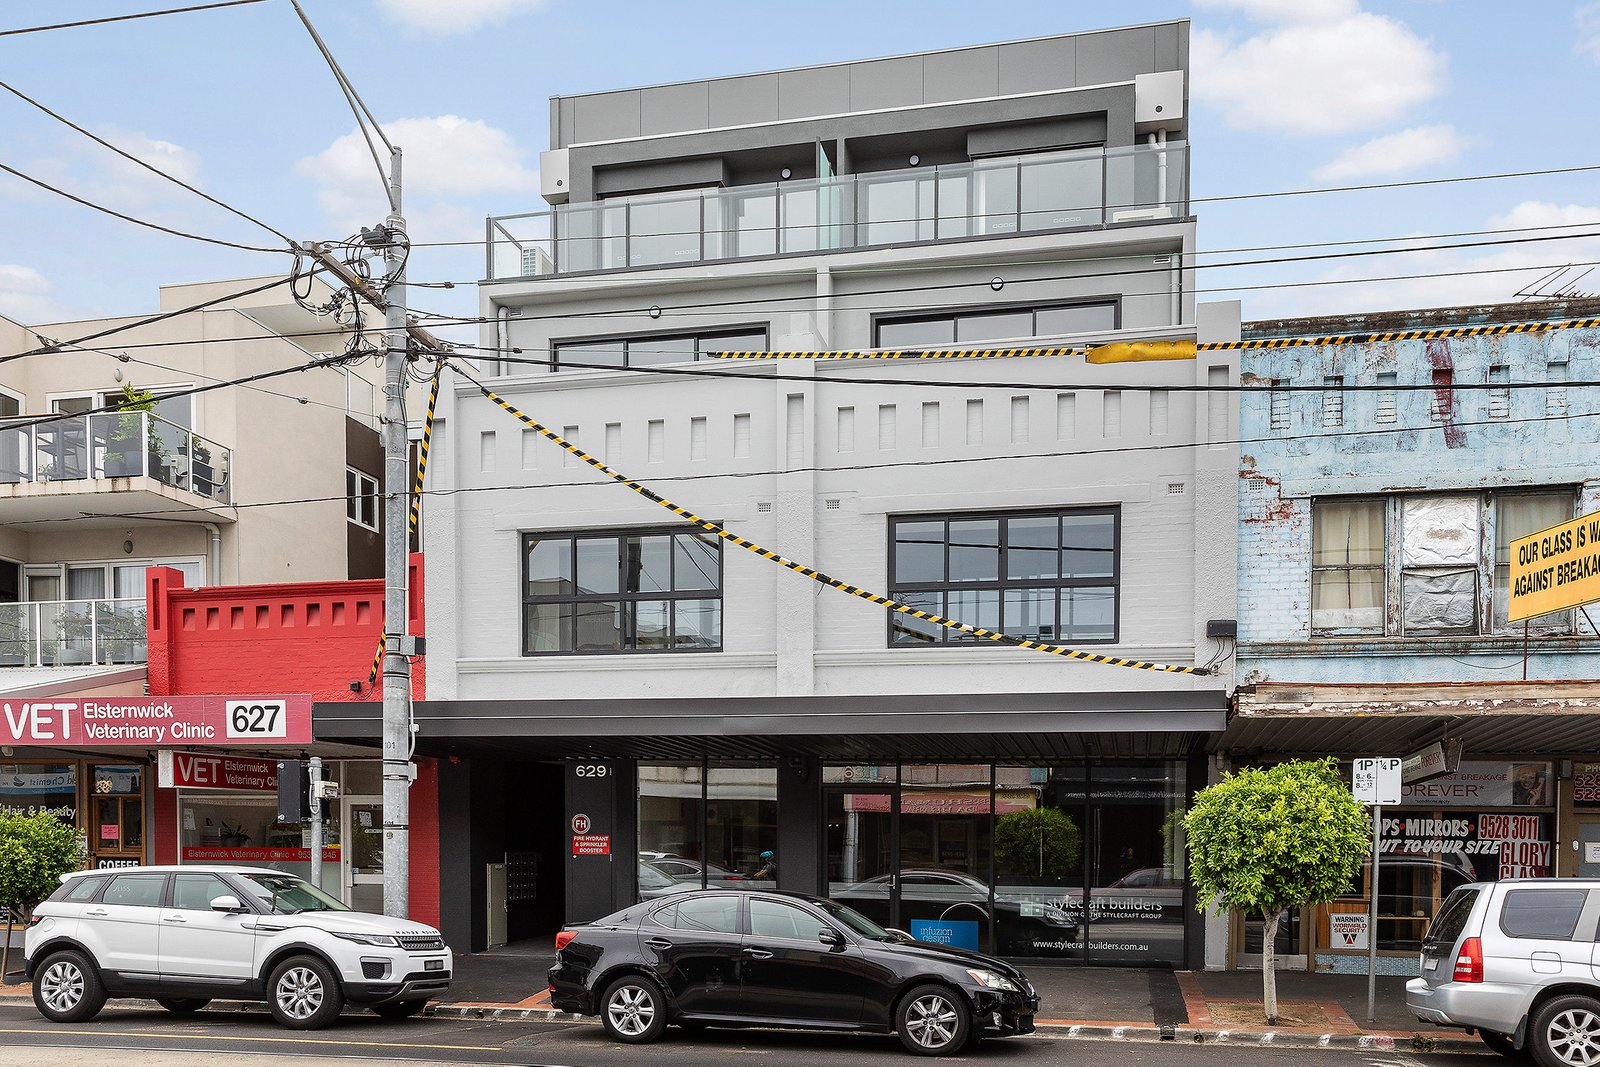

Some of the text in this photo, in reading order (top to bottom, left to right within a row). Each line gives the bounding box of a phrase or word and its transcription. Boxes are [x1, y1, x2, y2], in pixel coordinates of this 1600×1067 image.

[1519, 541, 1539, 567] OUR
[1541, 529, 1572, 560] GLASS
[1576, 525, 1586, 549] IS
[1514, 554, 1600, 598] AGAINST BREAKA
[83, 702, 174, 719] Elsternwick
[3, 702, 78, 740] VET
[232, 705, 281, 733] 627
[84, 721, 215, 742] Veterinary Clinic
[178, 755, 221, 784] VET
[224, 760, 269, 773] Elsternwick
[575, 765, 607, 777] 629
[1357, 760, 1374, 771] 1P
[1390, 760, 1400, 771] P
[225, 773, 264, 788] Veterinary
[1461, 773, 1508, 781] BREAKAGE
[1401, 784, 1484, 797] OREVER
[28, 805, 38, 816] &
[575, 819, 586, 828] FH
[1405, 818, 1469, 837] MIRRORS
[1480, 815, 1539, 840] 9528 3011
[188, 849, 228, 859] Elsternwick
[231, 850, 267, 860] Veterinary
[269, 851, 290, 859] Clinic
[1403, 839, 1425, 853] TO
[1421, 840, 1463, 856] YOUR
[1464, 841, 1500, 855] SIZE
[1501, 841, 1548, 867] GLORY
[1109, 897, 1163, 911] builders
[920, 926, 953, 937] infuzion
[922, 935, 951, 946] design
